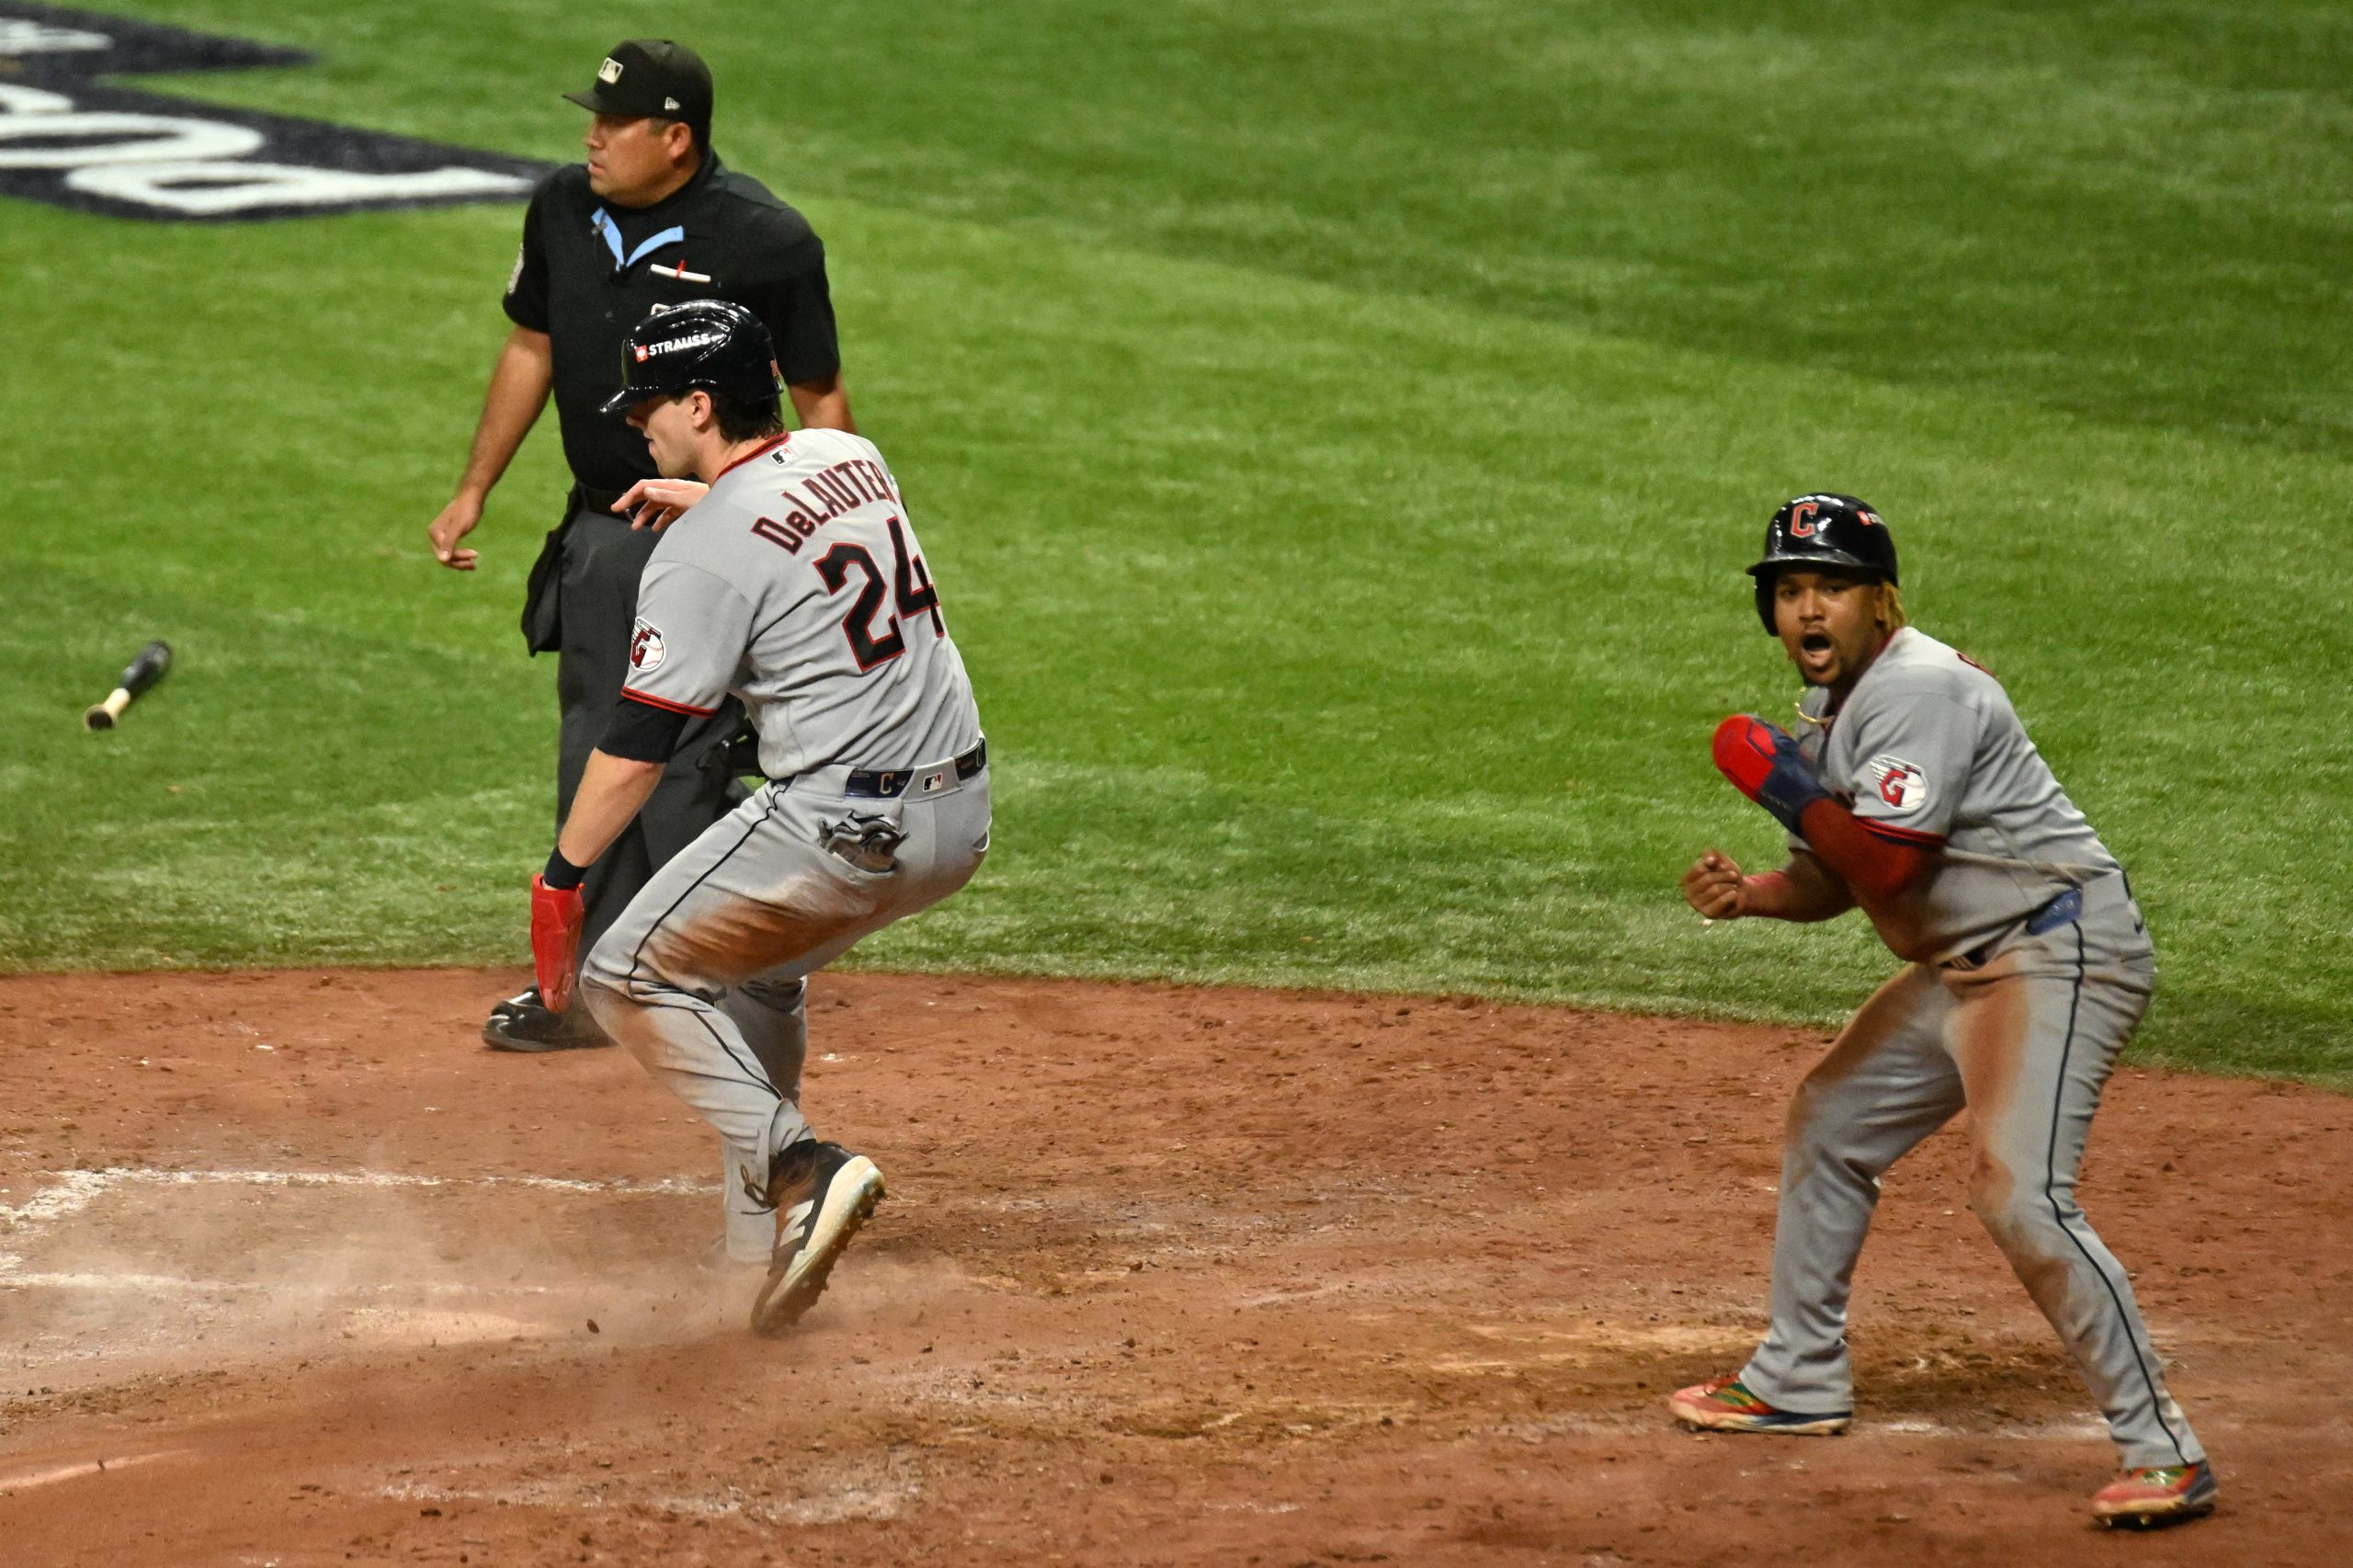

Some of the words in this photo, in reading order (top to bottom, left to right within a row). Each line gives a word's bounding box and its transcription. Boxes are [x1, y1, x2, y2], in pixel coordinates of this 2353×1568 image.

[648, 333, 710, 357] STRAUSS
[1790, 502, 1819, 538] C
[813, 516, 945, 672] 24
